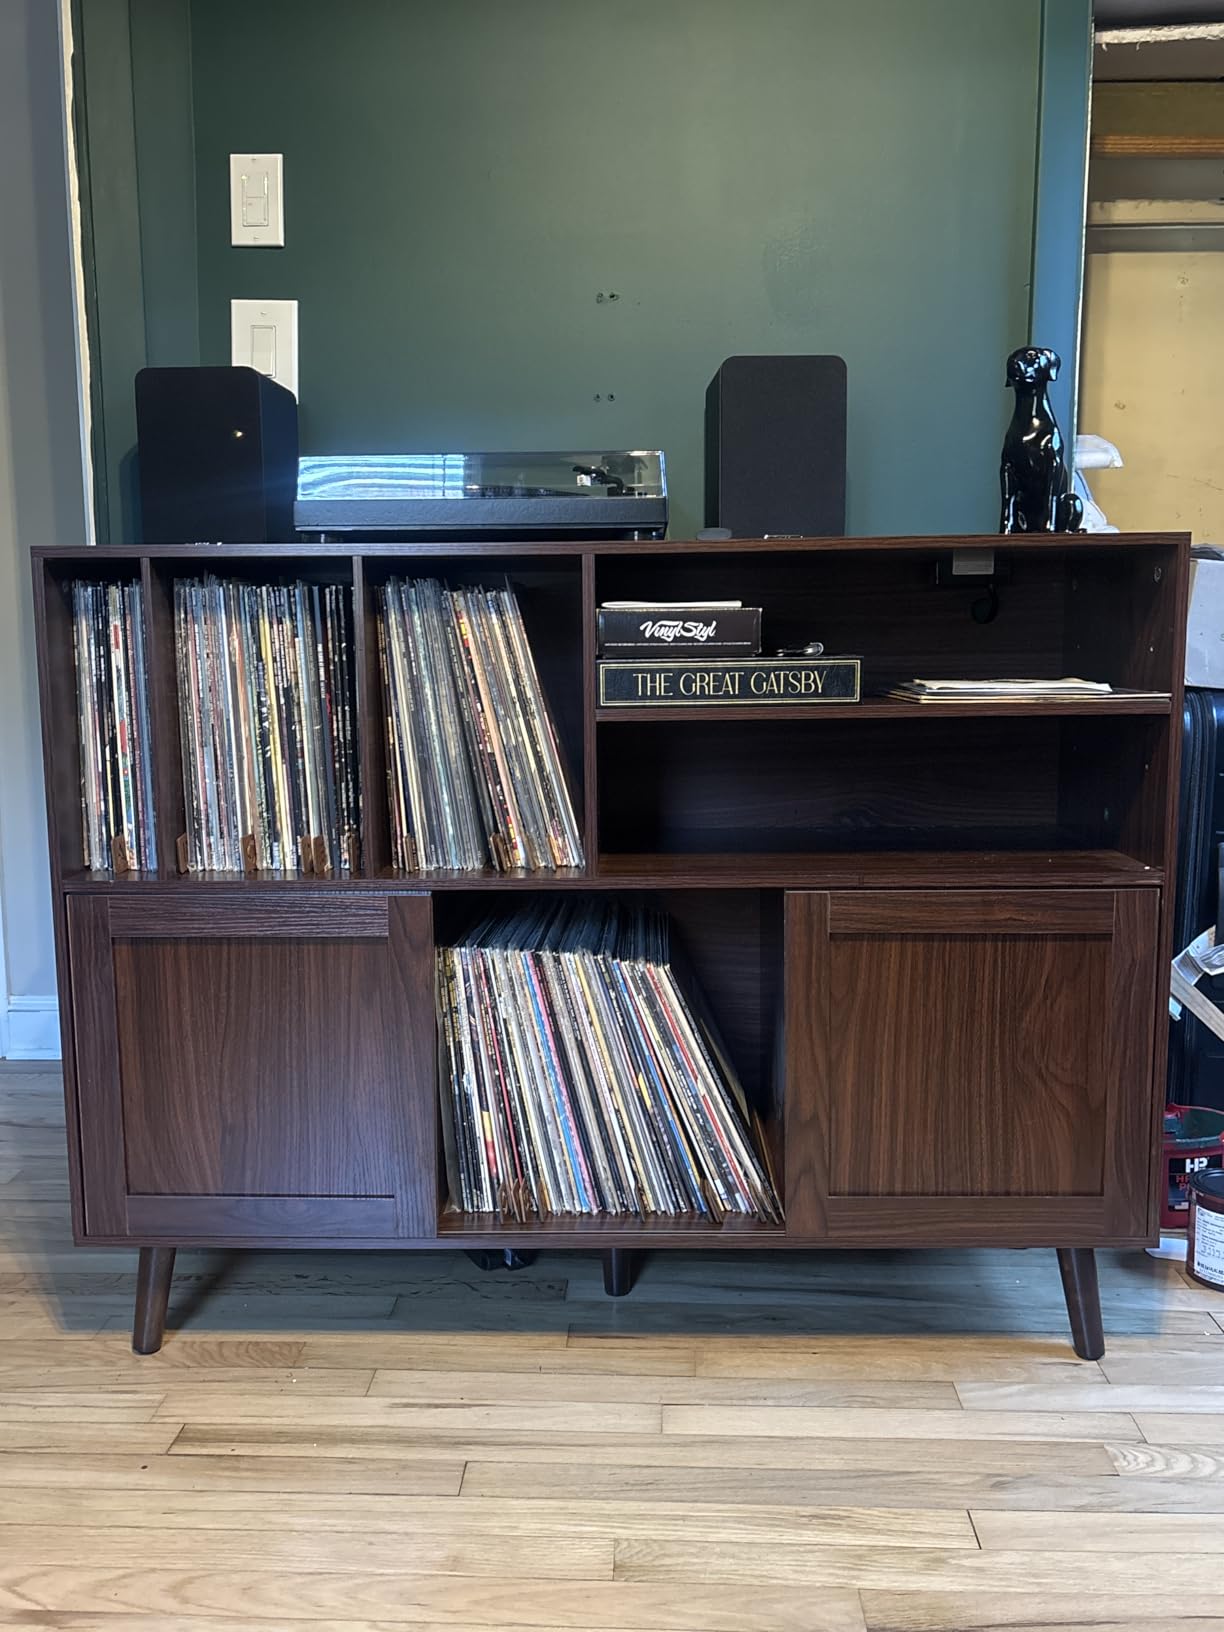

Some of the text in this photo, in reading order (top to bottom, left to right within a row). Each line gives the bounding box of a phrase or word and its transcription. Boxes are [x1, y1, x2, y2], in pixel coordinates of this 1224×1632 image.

[633, 670, 827, 696] THE GREAT GATSBY
